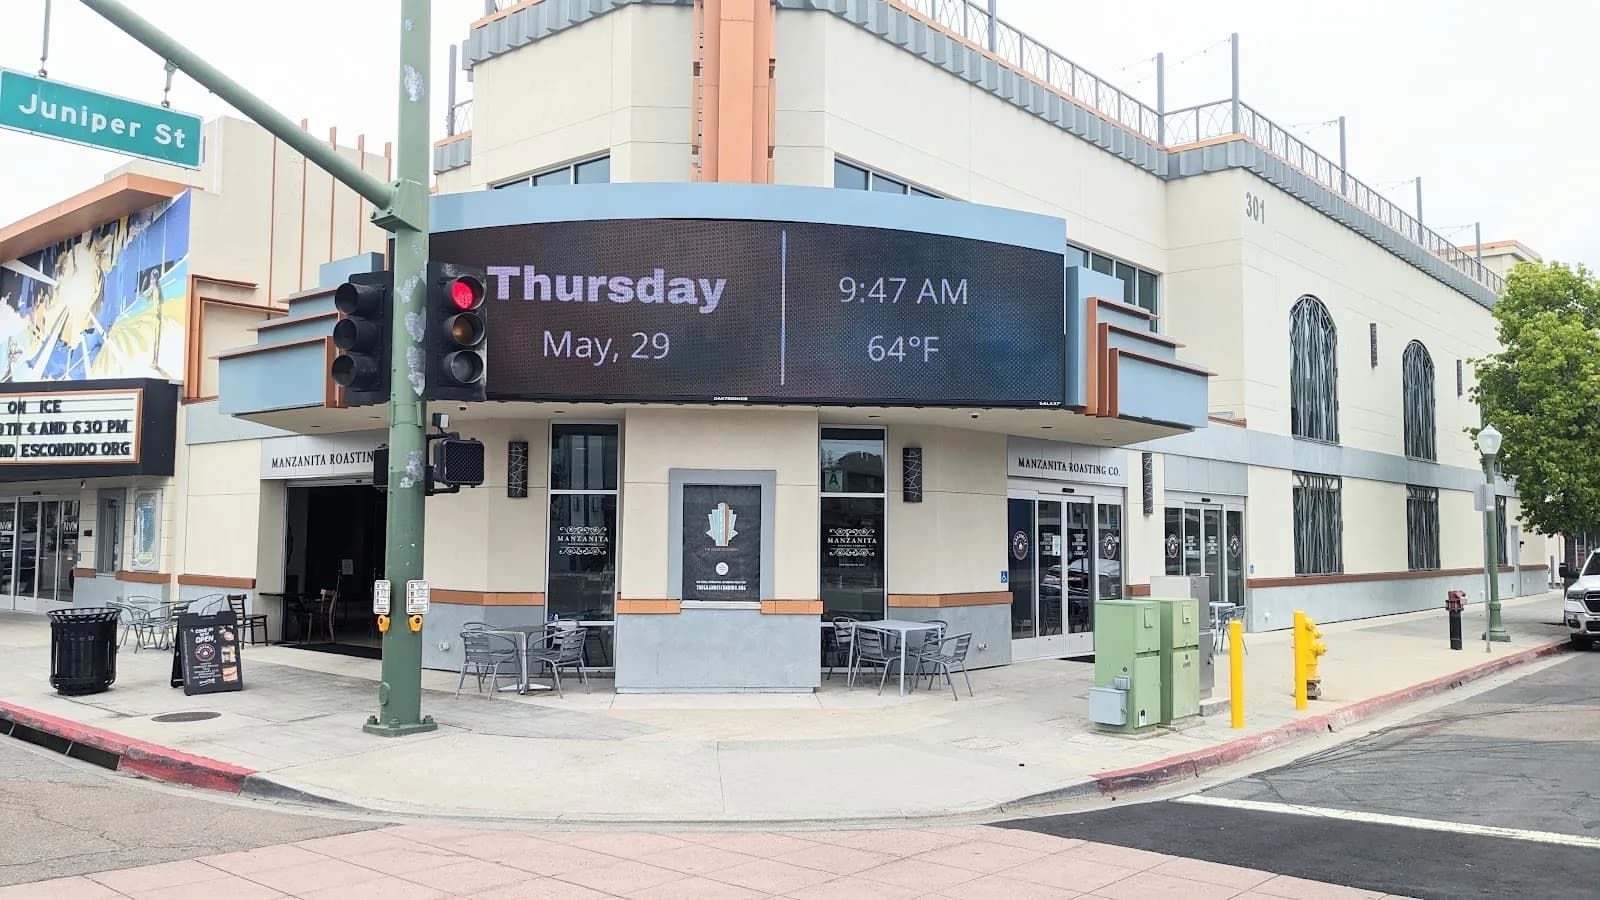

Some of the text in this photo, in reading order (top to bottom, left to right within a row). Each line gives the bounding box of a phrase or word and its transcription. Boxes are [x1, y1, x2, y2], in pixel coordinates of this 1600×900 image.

[18, 93, 186, 149] Juniper St
[1246, 191, 1265, 224] 301
[486, 265, 727, 314] Thursday
[839, 276, 968, 305] 9:47 AM
[543, 330, 670, 366] May, 29
[867, 335, 940, 363] 64°F
[8, 400, 62, 414] ON ICE
[27, 422, 36, 435] 4
[39, 421, 67, 435] AND
[107, 419, 128, 433] PM
[21, 442, 98, 457] ESCONDIDO
[101, 441, 130, 456] ORG
[271, 451, 374, 468] MANZANITA ROASTIN
[1018, 457, 1121, 476] MANZANITA ROASTING CO.
[557, 535, 609, 543] MANZANITA
[195, 635, 214, 644] OPEN
